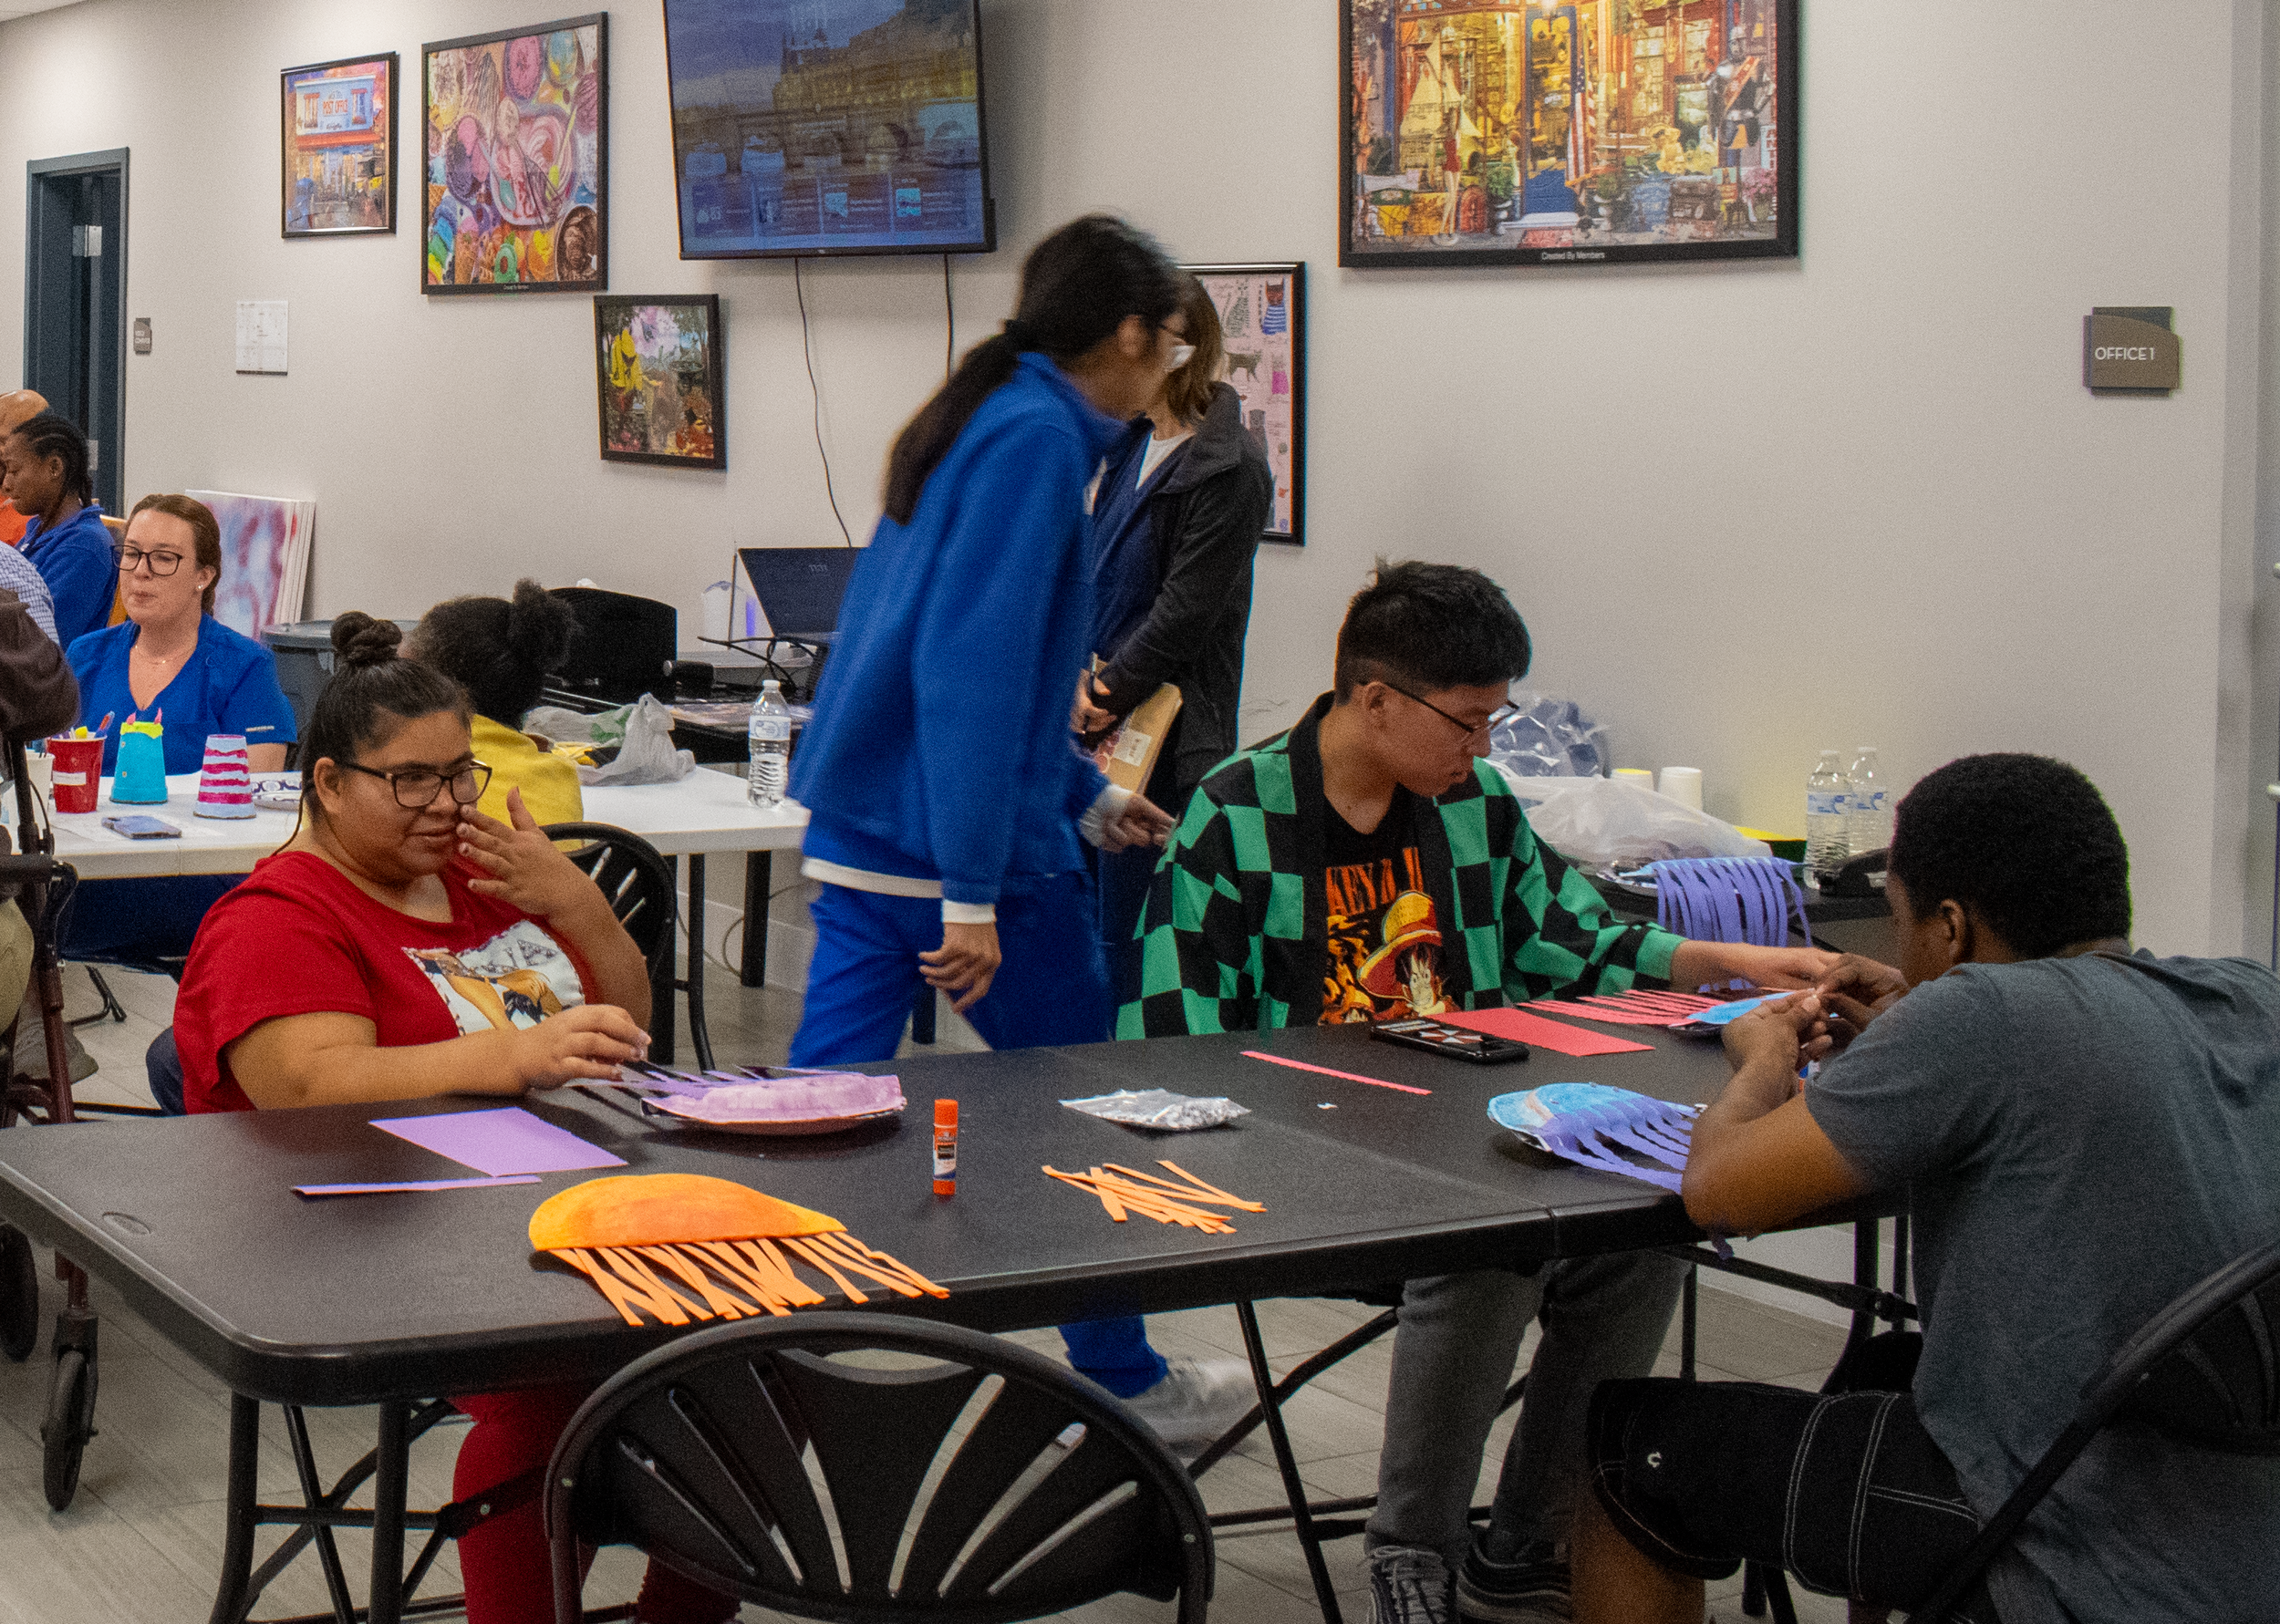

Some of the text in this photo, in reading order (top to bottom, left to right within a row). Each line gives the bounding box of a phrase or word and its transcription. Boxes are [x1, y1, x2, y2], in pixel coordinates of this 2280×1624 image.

[323, 98, 347, 114] POST OFFICE
[2095, 347, 2155, 360] OFFICE 1
